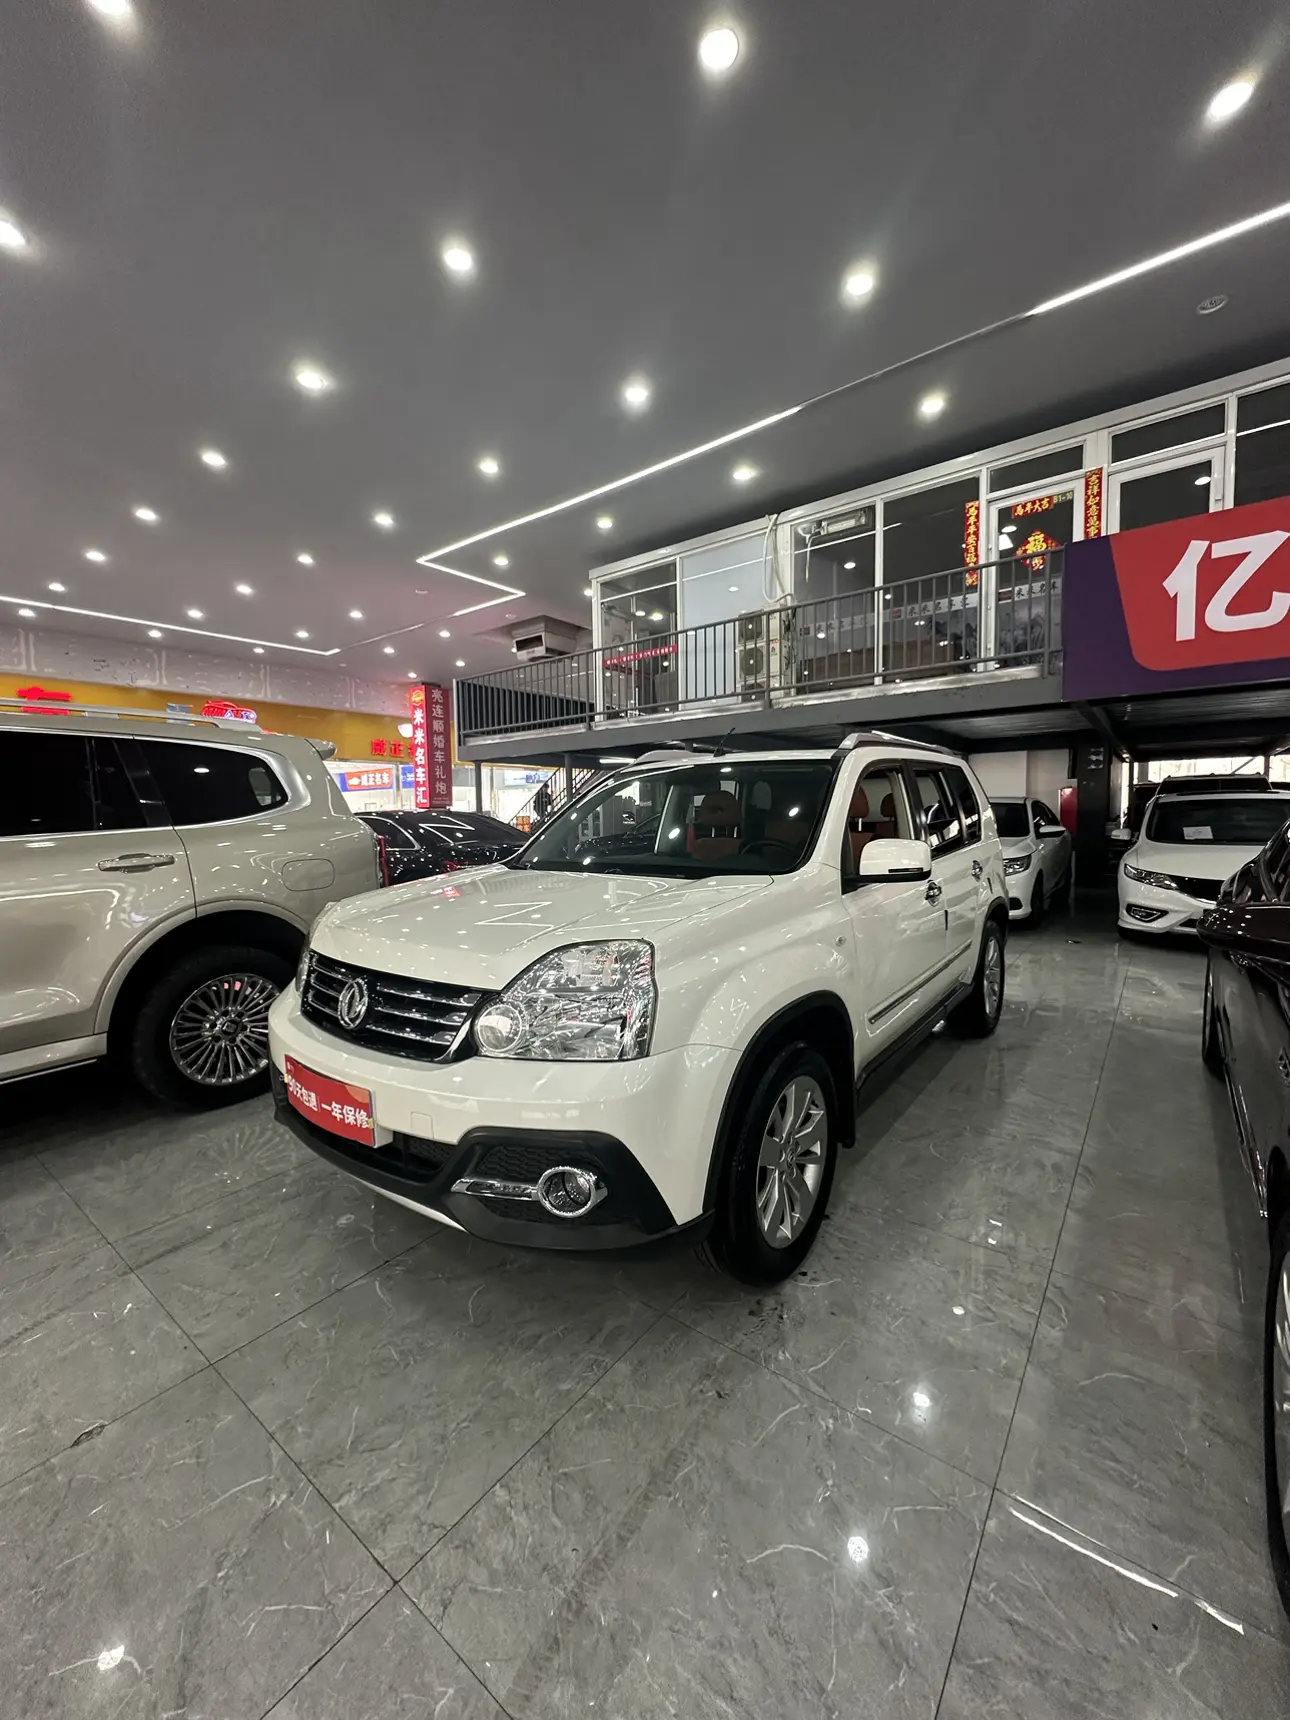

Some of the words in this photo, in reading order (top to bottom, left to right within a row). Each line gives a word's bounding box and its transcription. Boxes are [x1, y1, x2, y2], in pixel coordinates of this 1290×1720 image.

[1162, 529, 1290, 642] 亿
[413, 708, 428, 804] 米米名车汇
[321, 1101, 370, 1129] 一年保修
